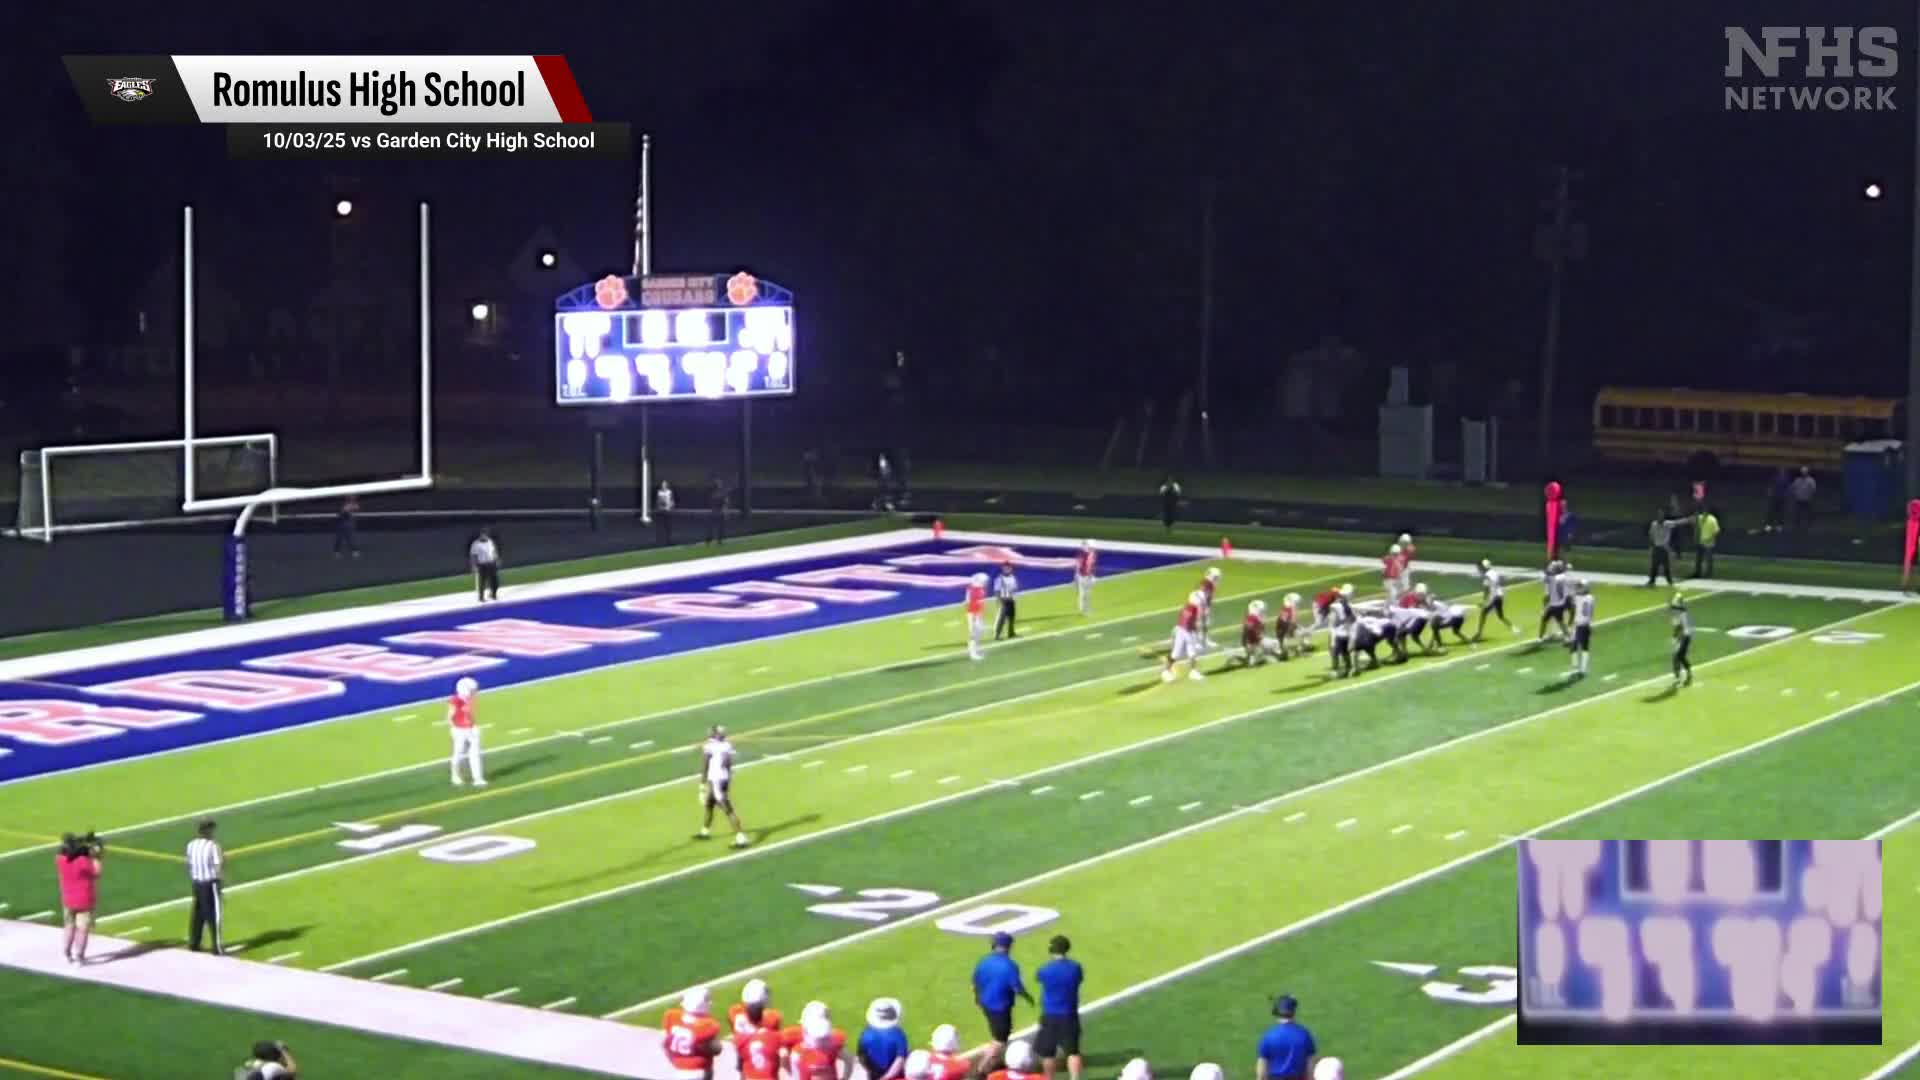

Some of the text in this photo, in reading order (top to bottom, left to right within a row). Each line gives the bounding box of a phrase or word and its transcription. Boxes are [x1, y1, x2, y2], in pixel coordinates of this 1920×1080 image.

[0, 546, 1077, 757] RDEN CITY
[804, 886, 1061, 936] 20
